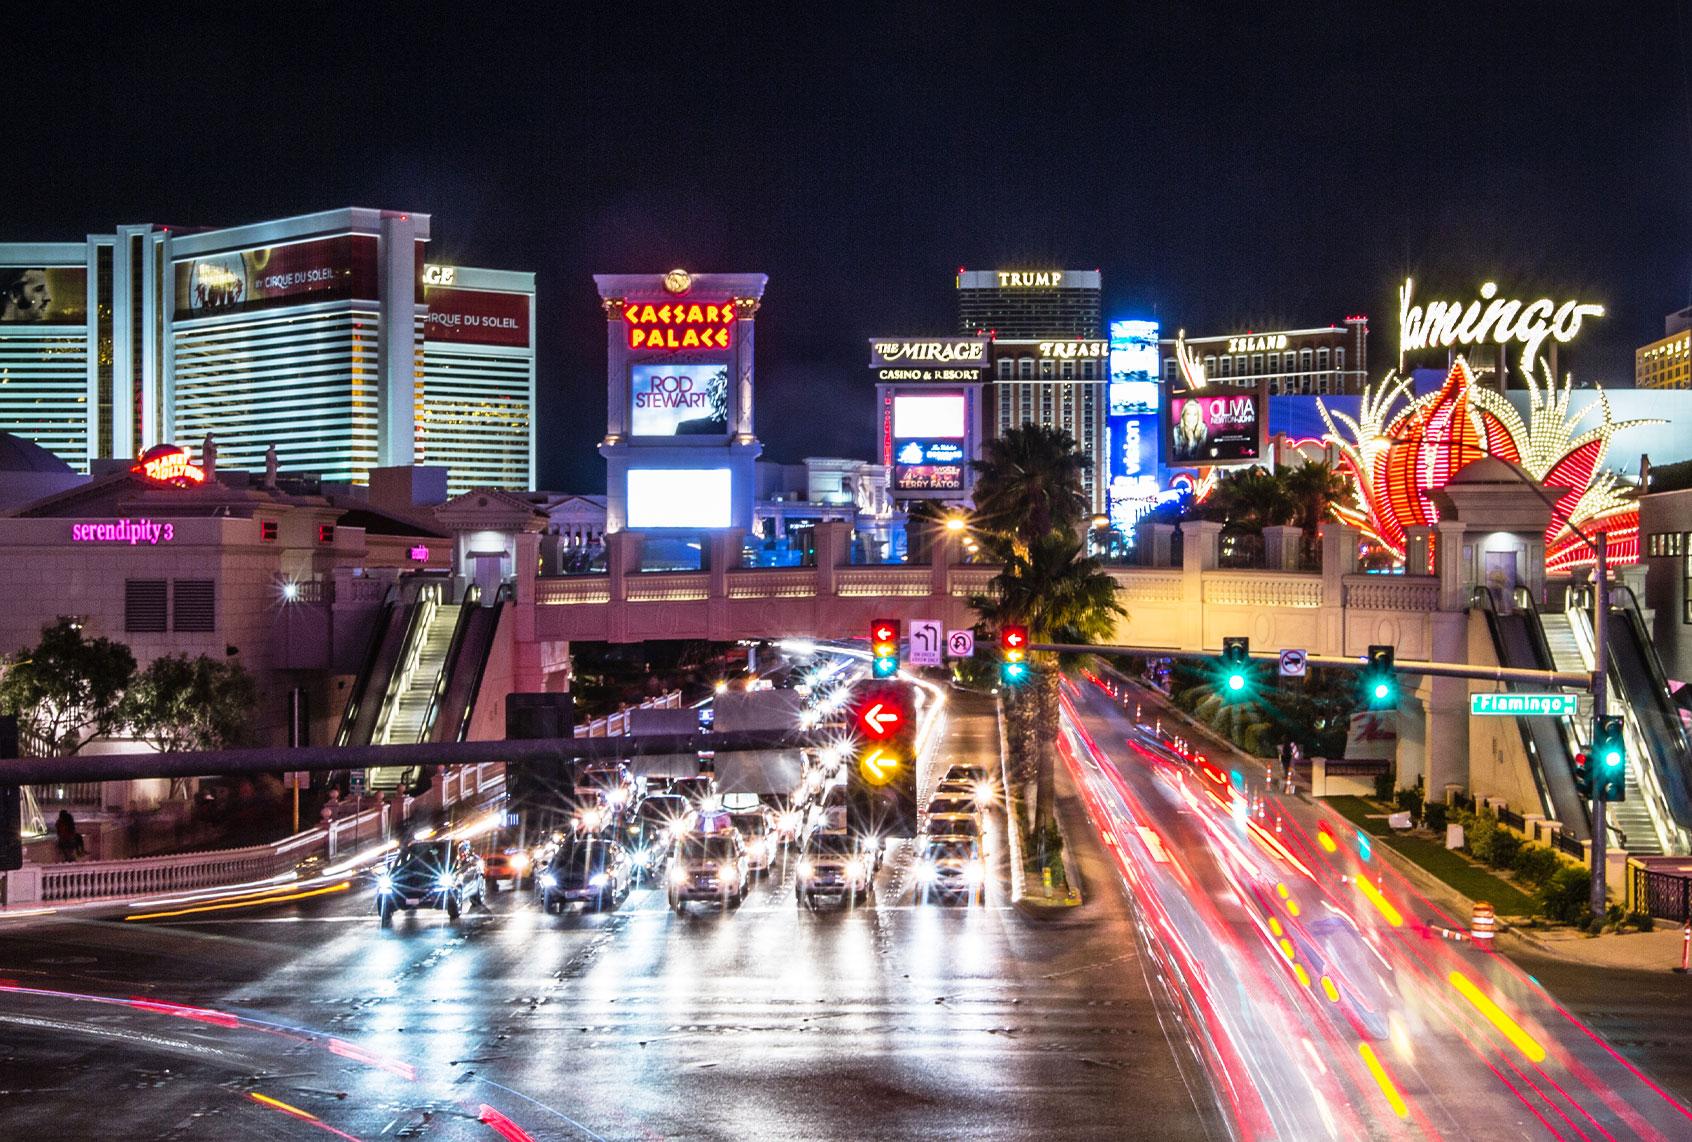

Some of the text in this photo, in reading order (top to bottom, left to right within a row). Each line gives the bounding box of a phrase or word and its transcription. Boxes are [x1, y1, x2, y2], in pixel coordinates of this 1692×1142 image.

[265, 273, 293, 289] CIRQUE
[295, 271, 306, 283] DU
[307, 267, 334, 282] SOLEIL
[422, 266, 453, 285] GE
[999, 272, 1062, 287] TRUMP
[464, 315, 480, 326] DU
[482, 316, 519, 329] SOLEIL
[625, 304, 734, 324] CAESARS
[632, 328, 728, 347] PALACE
[1228, 335, 1287, 353] ISLAND
[875, 343, 983, 362] THE MIRAGE
[879, 369, 980, 380] CASINO & RESORT
[650, 376, 693, 393] ROD
[635, 393, 708, 408] STEWART
[1210, 398, 1255, 418] OLIVIA
[899, 480, 929, 489] TERRY
[73, 519, 174, 545] serendipity 3
[1481, 694, 1562, 714] Flamingo
